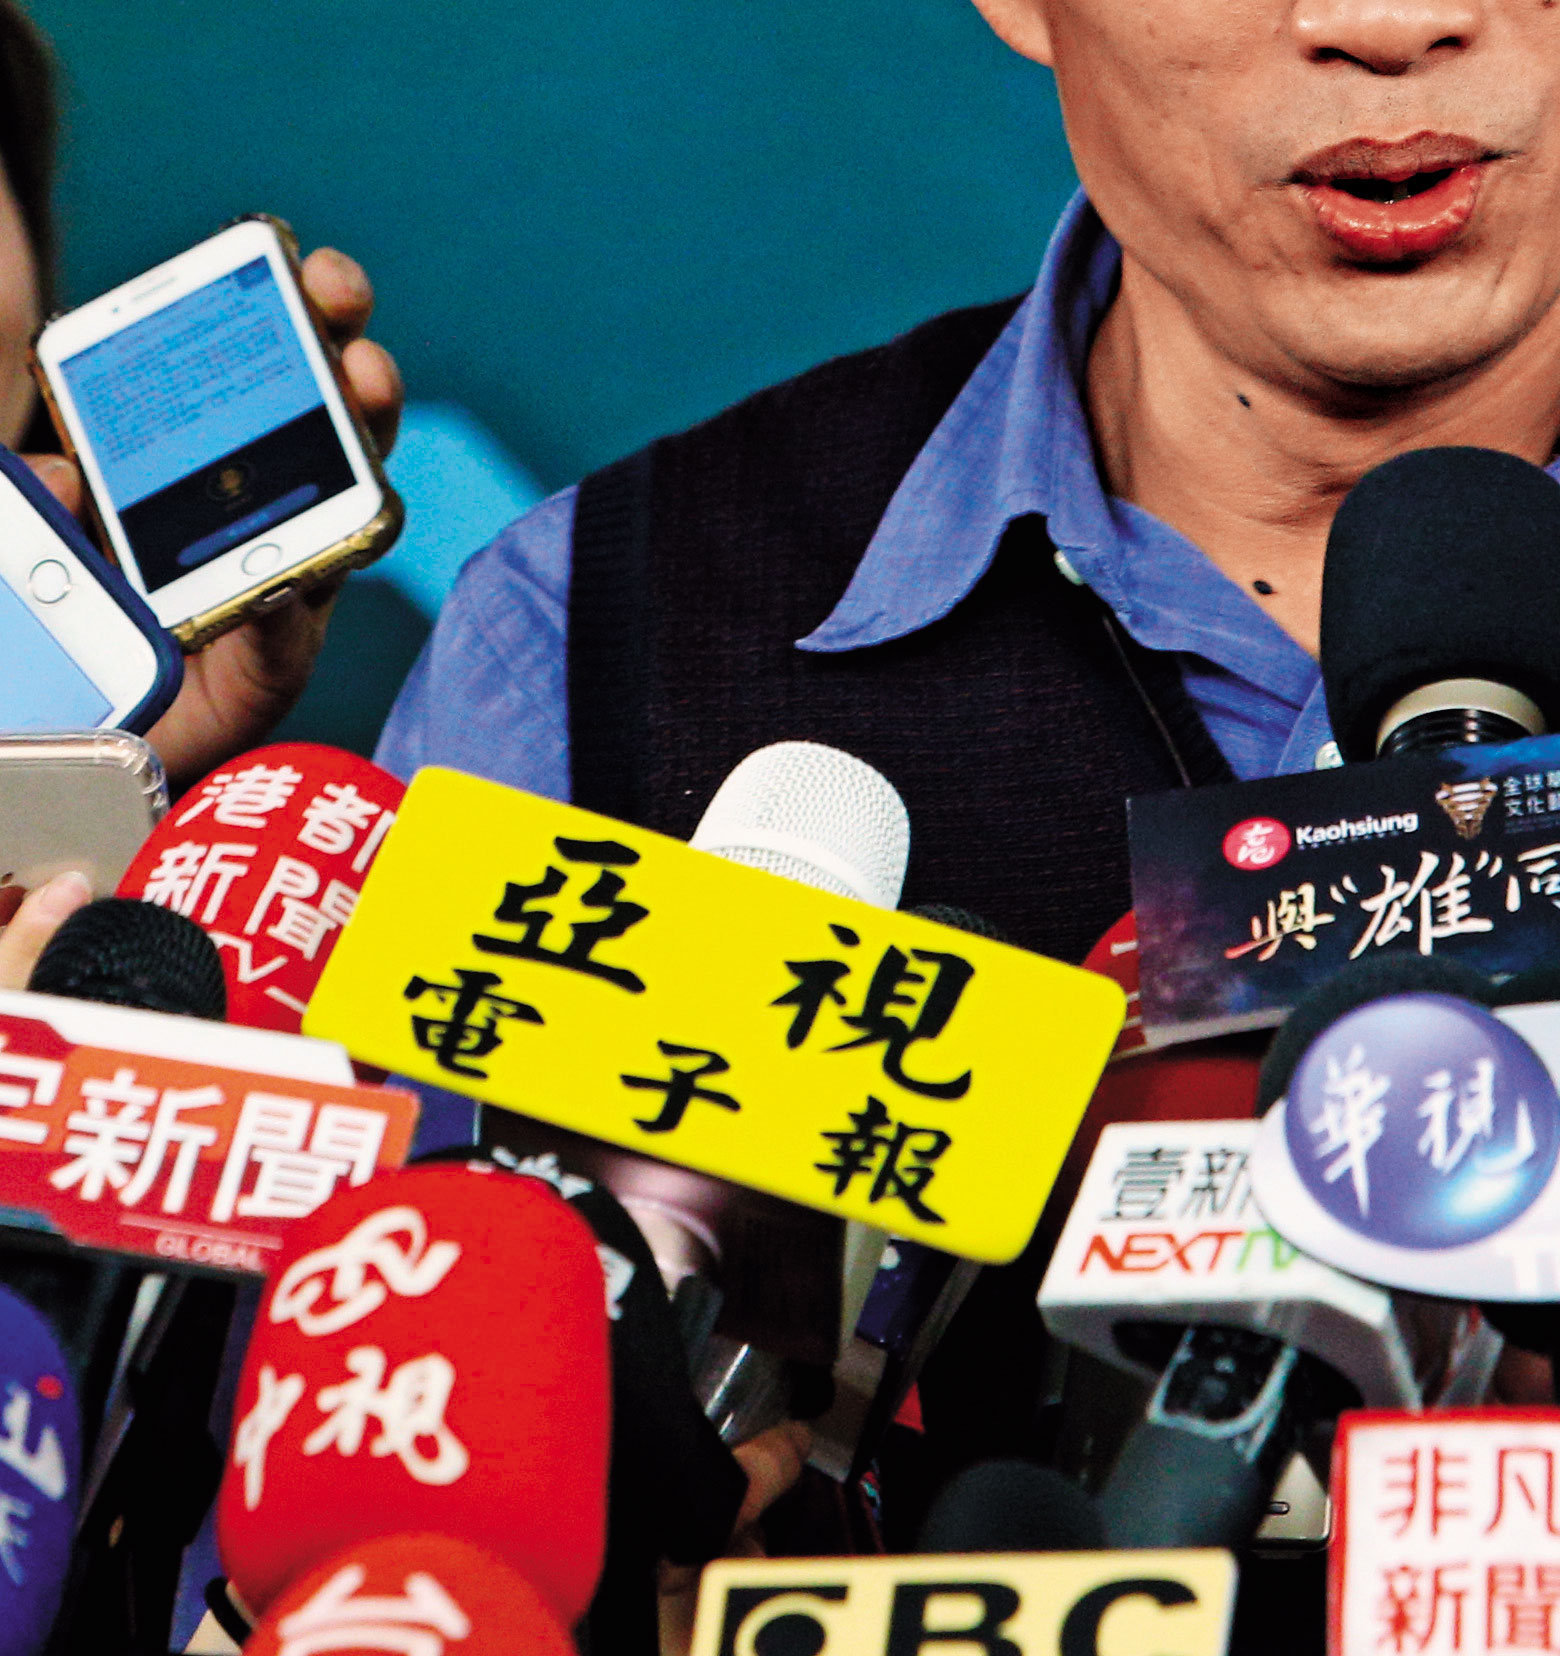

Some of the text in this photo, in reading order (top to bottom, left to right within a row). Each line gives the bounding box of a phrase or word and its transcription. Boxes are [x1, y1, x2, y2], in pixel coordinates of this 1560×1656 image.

[140, 840, 360, 962] 新聞
[174, 764, 398, 874] 港都
[1295, 811, 1419, 847] Kaohsiung
[471, 835, 976, 1100] 亞視
[402, 968, 953, 1226] 電子報
[1308, 1044, 1536, 1221] 華視
[234, 1345, 471, 1512] 中視
